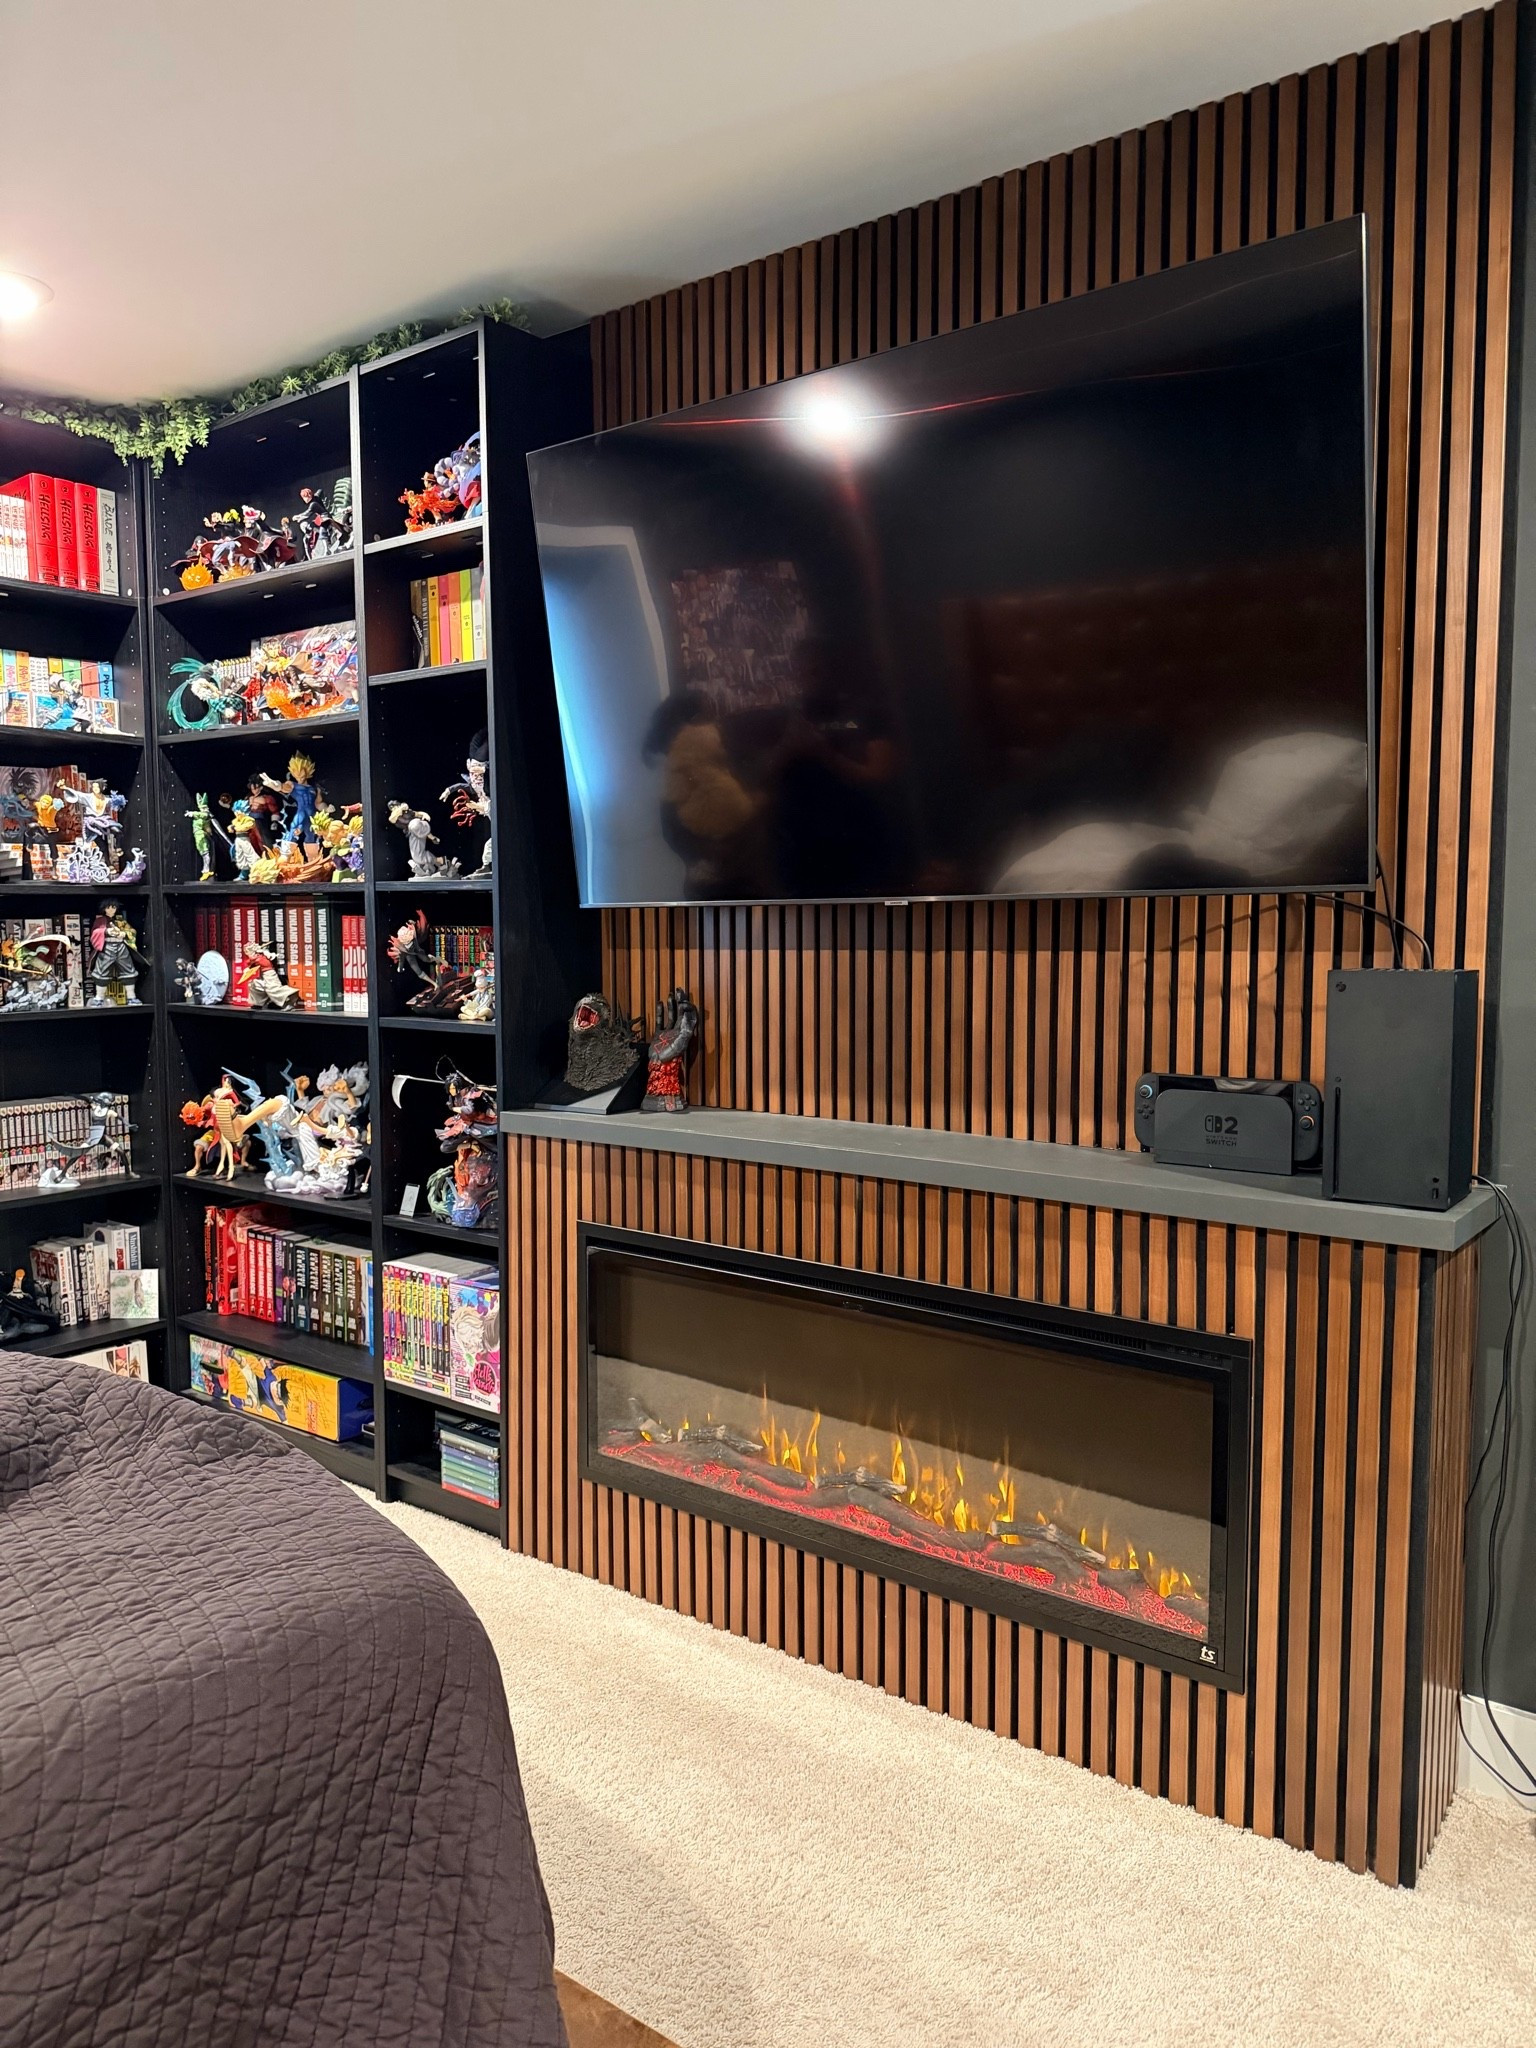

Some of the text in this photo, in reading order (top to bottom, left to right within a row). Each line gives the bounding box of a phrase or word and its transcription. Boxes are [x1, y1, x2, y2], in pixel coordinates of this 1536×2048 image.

[39, 493, 51, 540] HELLSING
[60, 499, 72, 544] HELLSING
[82, 503, 95, 548] HELLSING
[102, 502, 115, 536] BLADE
[412, 615, 423, 639] solanin
[234, 909, 242, 963] VINLAND SAGA
[247, 909, 255, 942] VINLAND
[261, 909, 270, 942] VINLAND
[275, 909, 285, 965] VINLAND SAGA
[288, 909, 299, 965] VINLAND SAGA
[303, 909, 313, 967] VINLAND SAGA
[317, 909, 328, 966] VINLAND SAGA
[1206, 1138, 1237, 1147] SWITCH
[1224, 1116, 1238, 1135] 2
[1200, 1646, 1216, 1660] ts
